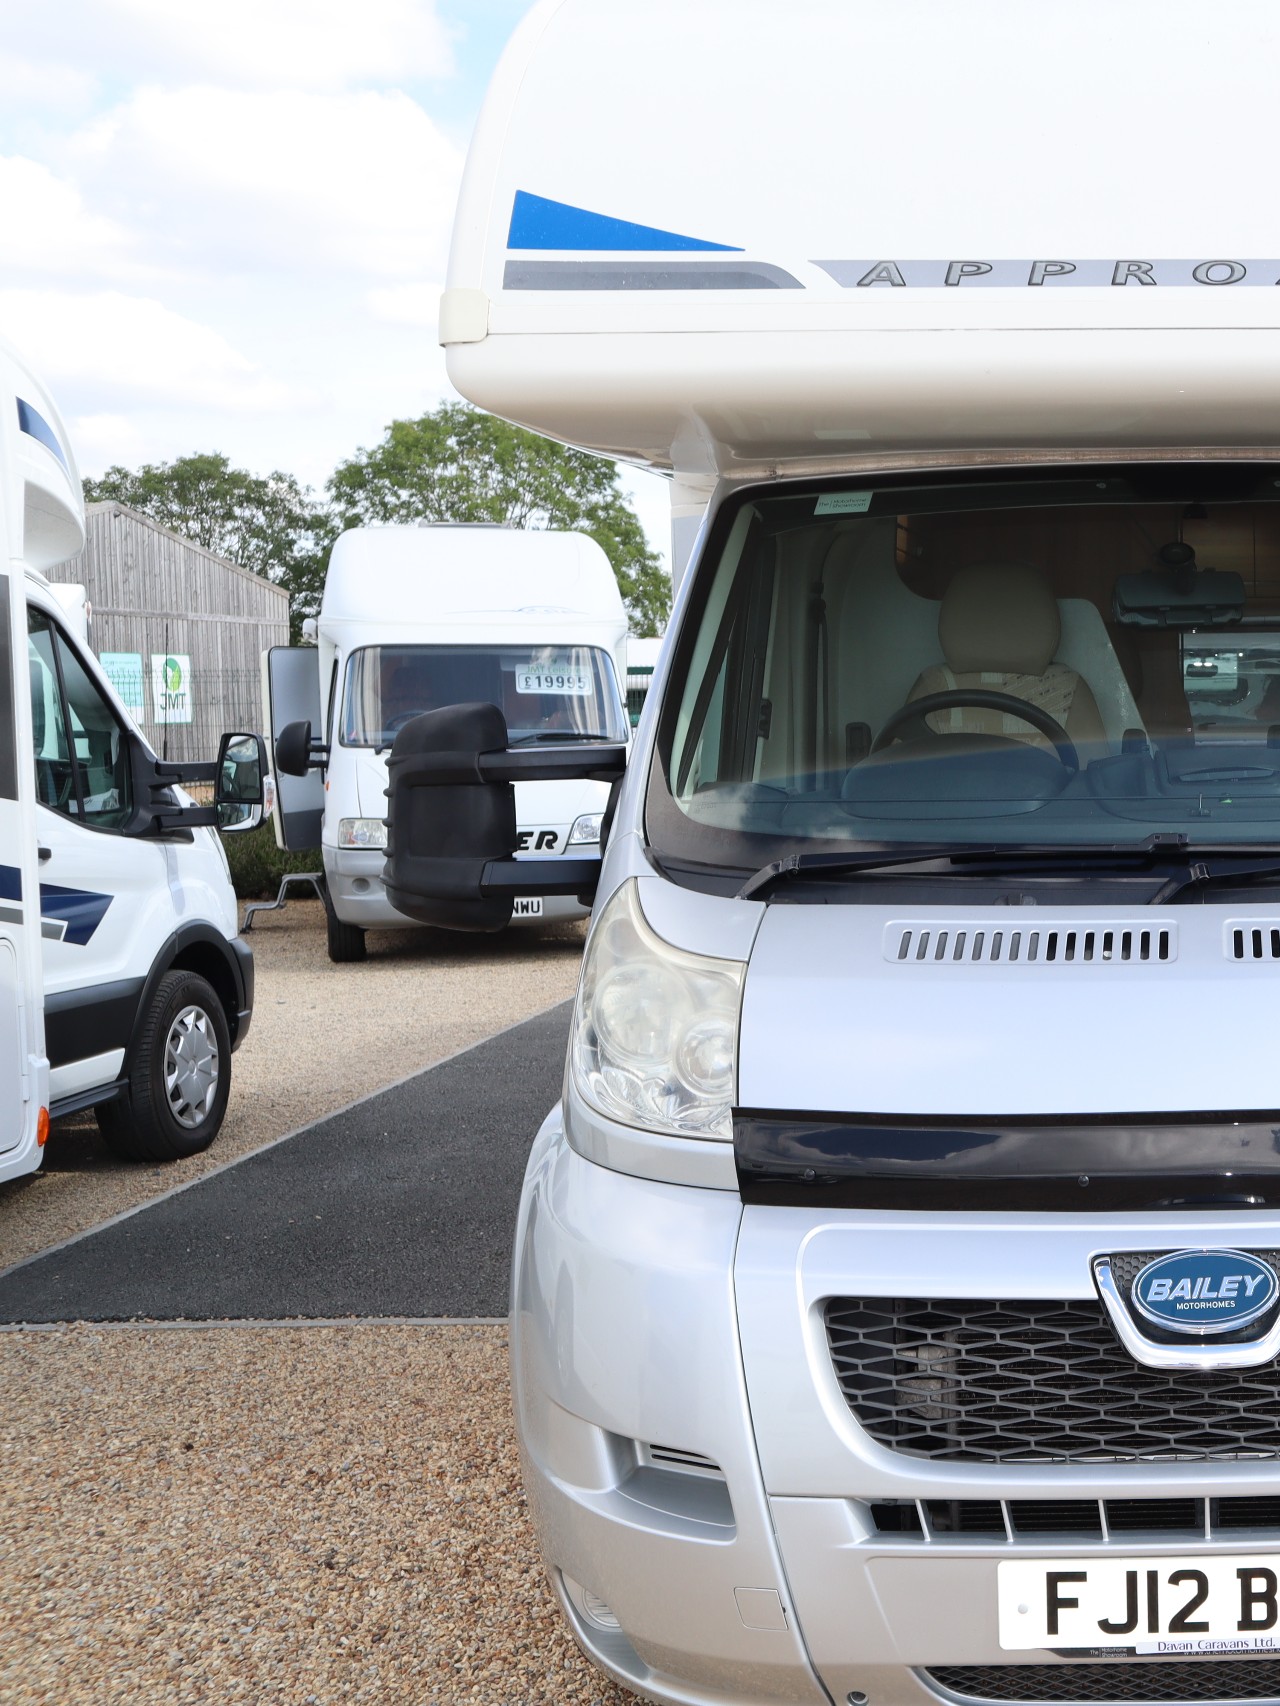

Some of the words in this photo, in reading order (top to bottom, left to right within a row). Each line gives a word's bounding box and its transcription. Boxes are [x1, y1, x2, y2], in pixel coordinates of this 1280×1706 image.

[524, 675, 586, 690] £19995
[160, 692, 187, 711] JMT
[1146, 1273, 1265, 1303] BAILEY
[1176, 1300, 1236, 1310] MOTORHOMES
[1046, 1568, 1209, 1635] FJ12
[1157, 1641, 1193, 1652] Davan
[1197, 1639, 1249, 1650] Caravans
[1254, 1637, 1276, 1648] Ltd.
